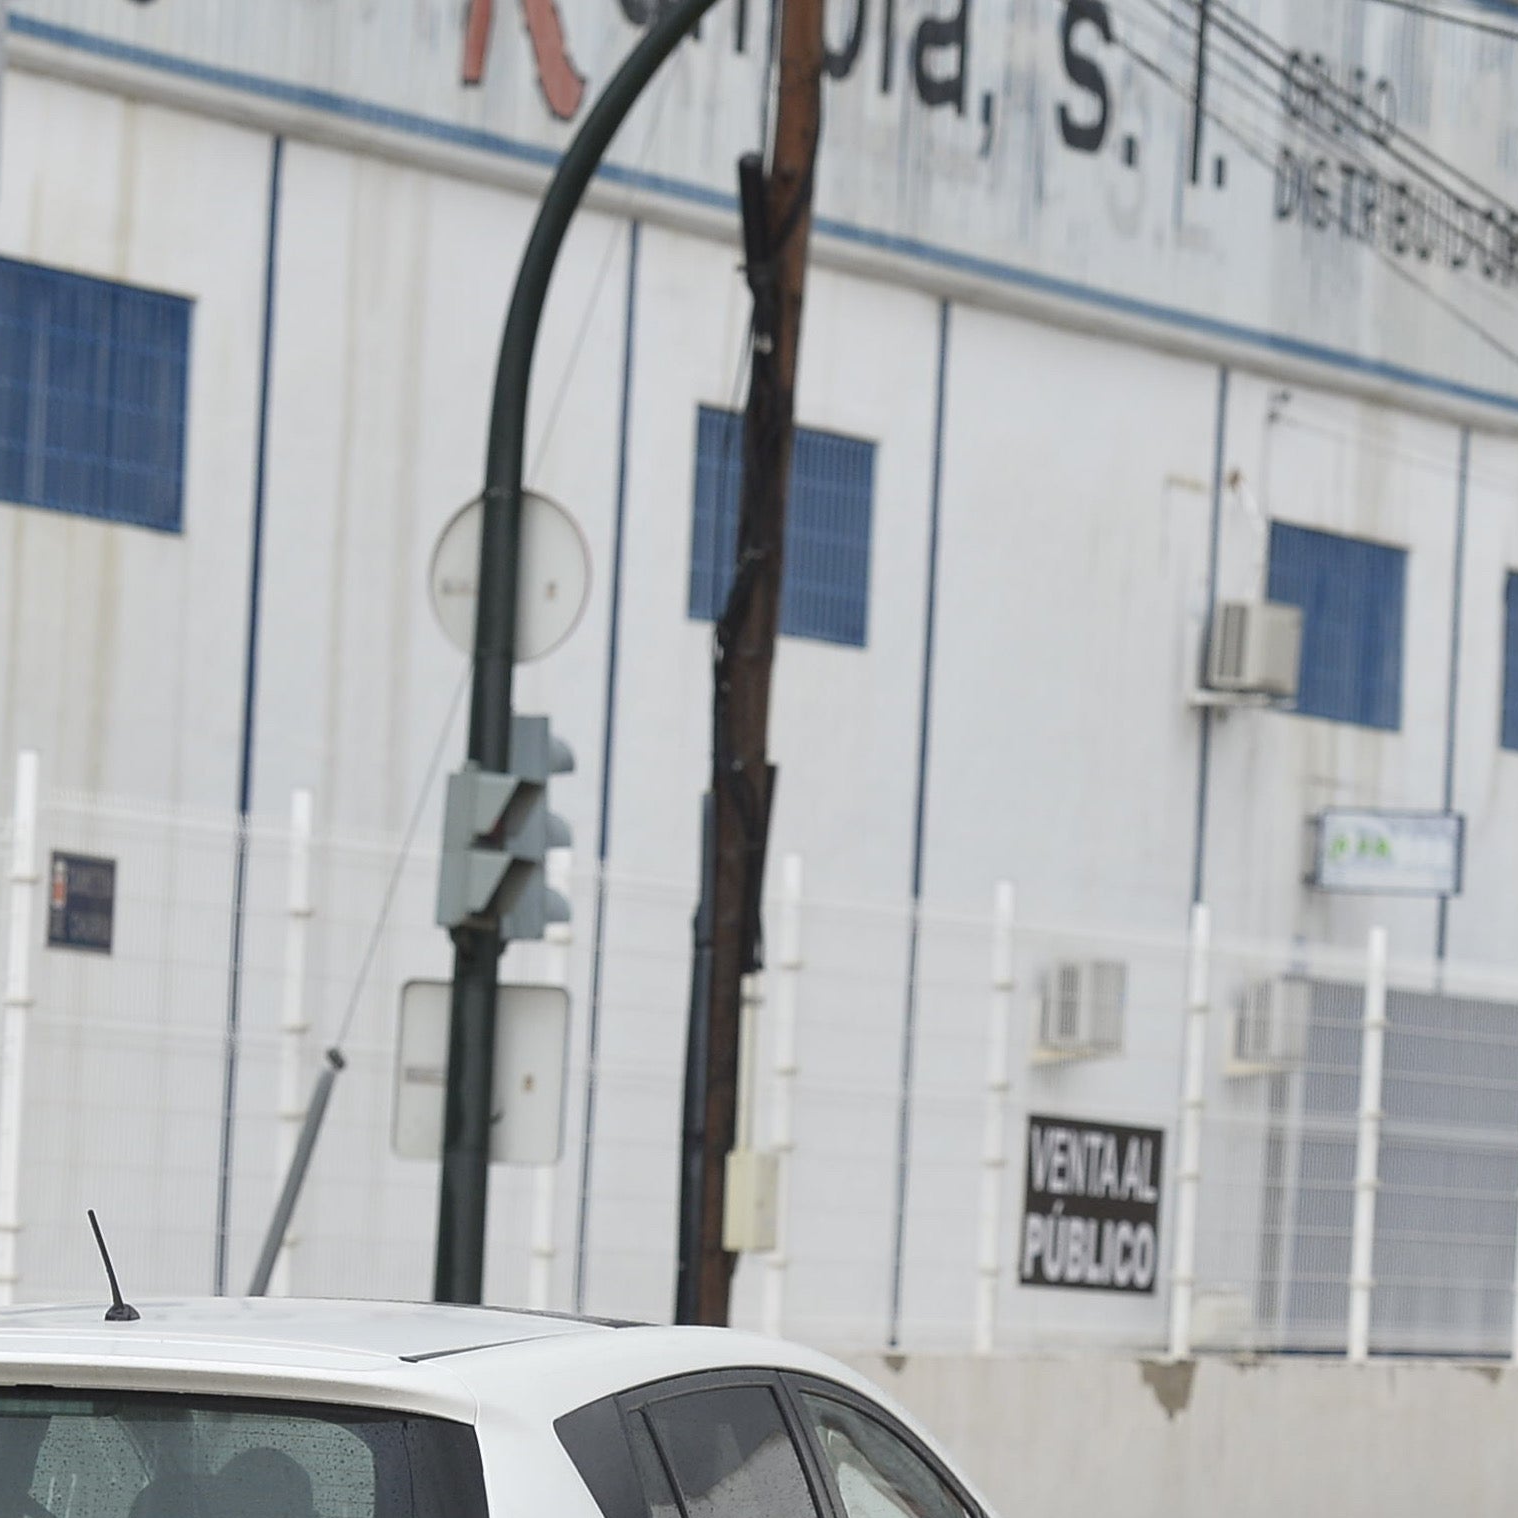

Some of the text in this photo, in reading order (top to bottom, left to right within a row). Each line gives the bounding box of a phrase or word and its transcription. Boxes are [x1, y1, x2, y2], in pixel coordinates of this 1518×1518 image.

[1032, 1124, 1157, 1204] VENTA AL
[1023, 1199, 1155, 1288] PÚBLICO
